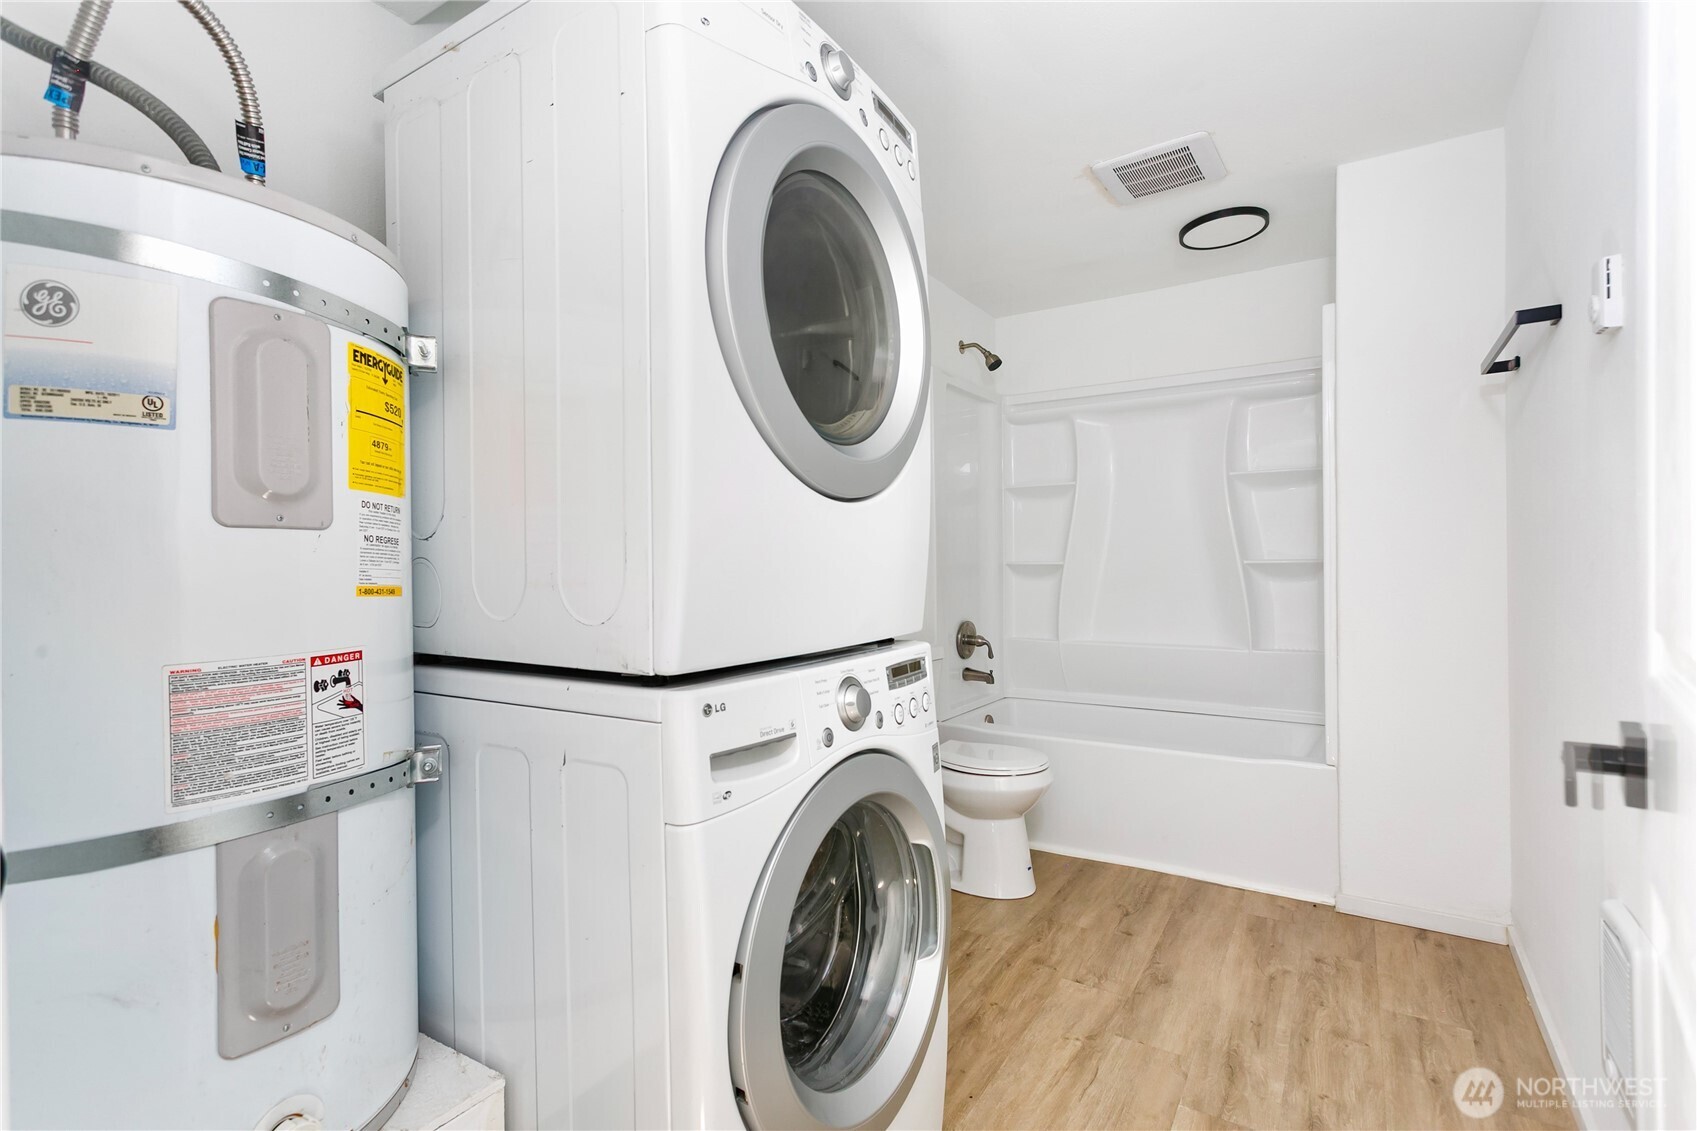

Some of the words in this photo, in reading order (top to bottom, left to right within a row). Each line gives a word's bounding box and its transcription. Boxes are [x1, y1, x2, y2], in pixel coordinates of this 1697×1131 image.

[372, 440, 388, 451] 4879
[361, 500, 371, 509] DO
[372, 502, 383, 511] NOT
[384, 504, 400, 514] RETURN
[364, 534, 374, 543] NO
[375, 536, 400, 546] REGRESE
[324, 652, 360, 664] DANGER
[715, 702, 726, 713] LG
[760, 728, 773, 738] Direct
